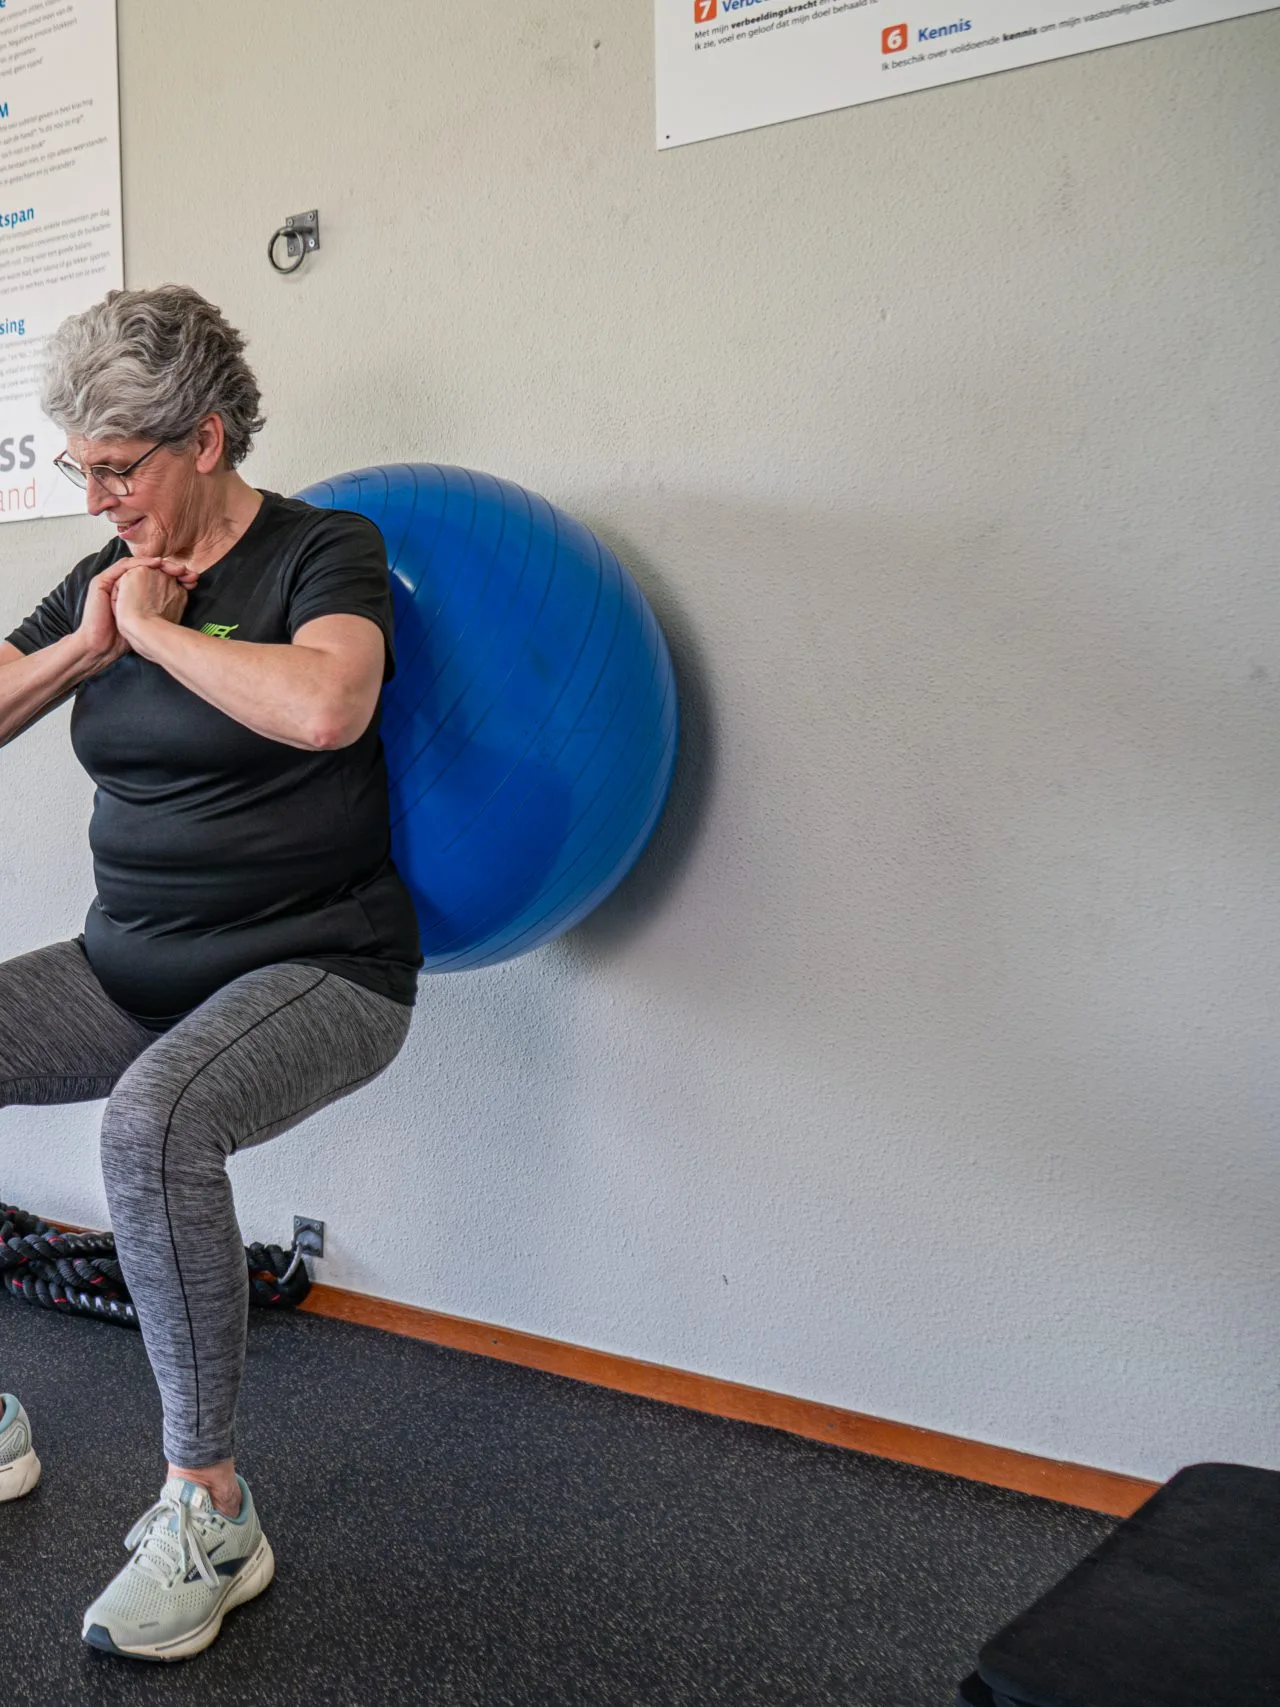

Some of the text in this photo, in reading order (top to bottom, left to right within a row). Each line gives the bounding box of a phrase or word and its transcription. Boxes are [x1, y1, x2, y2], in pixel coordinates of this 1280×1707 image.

[694, 29, 710, 39] Met
[711, 23, 729, 36] mijn
[731, 0, 817, 29] verbeeldingskracht
[694, 42, 701, 50] Ik
[718, 34, 734, 45] voel
[736, 31, 746, 40] en
[748, 23, 774, 38] geloof
[775, 19, 790, 30] dat
[791, 13, 810, 25] mijn
[812, 8, 830, 20] doel
[833, 0, 867, 14] behaald
[888, 18, 972, 50] 6 Kennis
[881, 61, 889, 71] Ik
[892, 53, 926, 68] beschik
[928, 49, 948, 61] over
[950, 36, 1000, 54] voldoende
[1002, 26, 1038, 42] kennis
[1040, 23, 1057, 33] om
